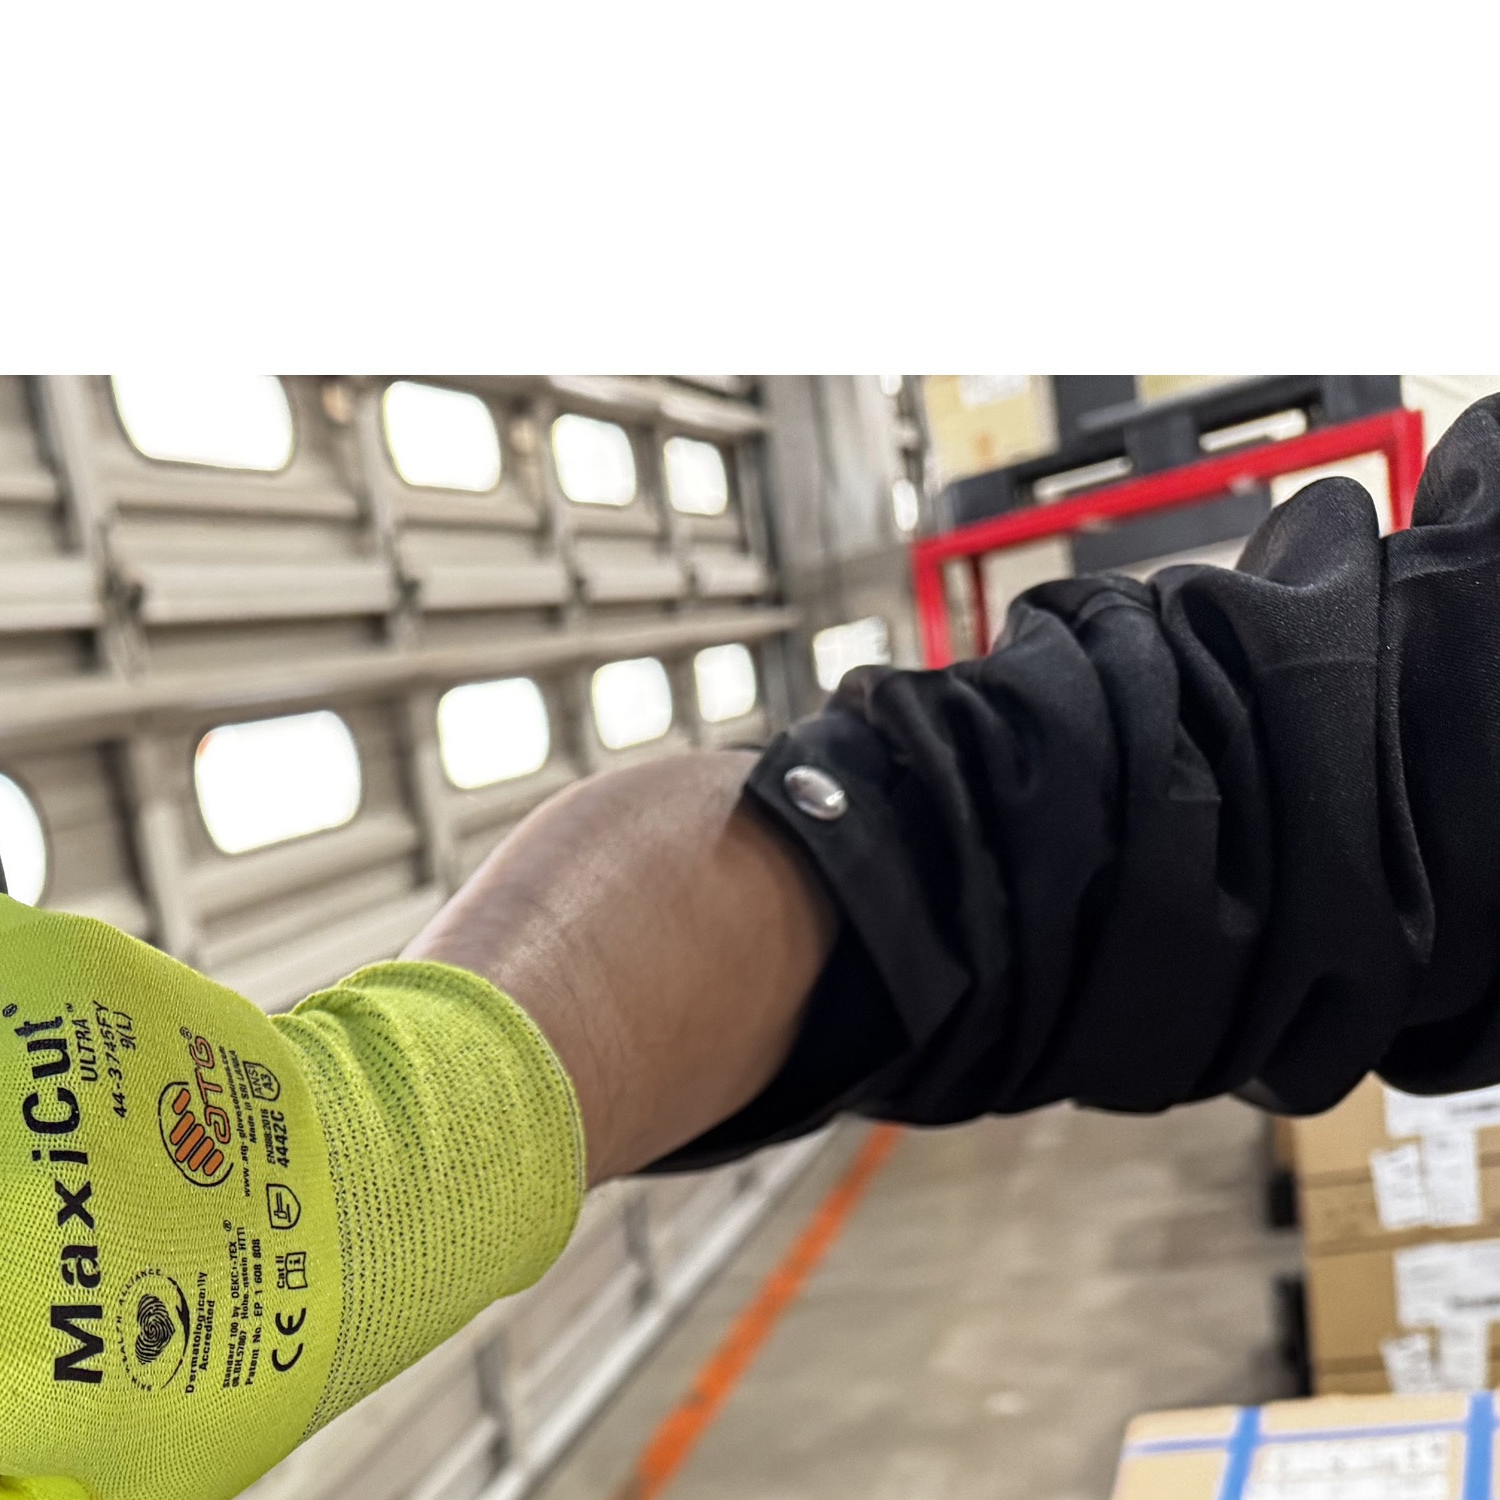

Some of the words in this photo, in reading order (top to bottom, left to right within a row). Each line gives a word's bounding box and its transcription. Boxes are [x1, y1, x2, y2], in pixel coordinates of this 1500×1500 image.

[71, 1018, 98, 1082] ULTRA
[238, 1083, 250, 1100] SRI
[247, 1065, 264, 1096] ANSI
[260, 1073, 274, 1092] A3
[248, 1115, 257, 1144] Made
[271, 1110, 290, 1168] 4442C
[254, 1264, 263, 1283] 608
[276, 1268, 286, 1289] Cat
[253, 1303, 263, 1317] EP
[199, 1300, 215, 1371] Accredited
[223, 1343, 236, 1389] Standard
[230, 1322, 239, 1338] 100
[245, 1350, 260, 1385] Patent
